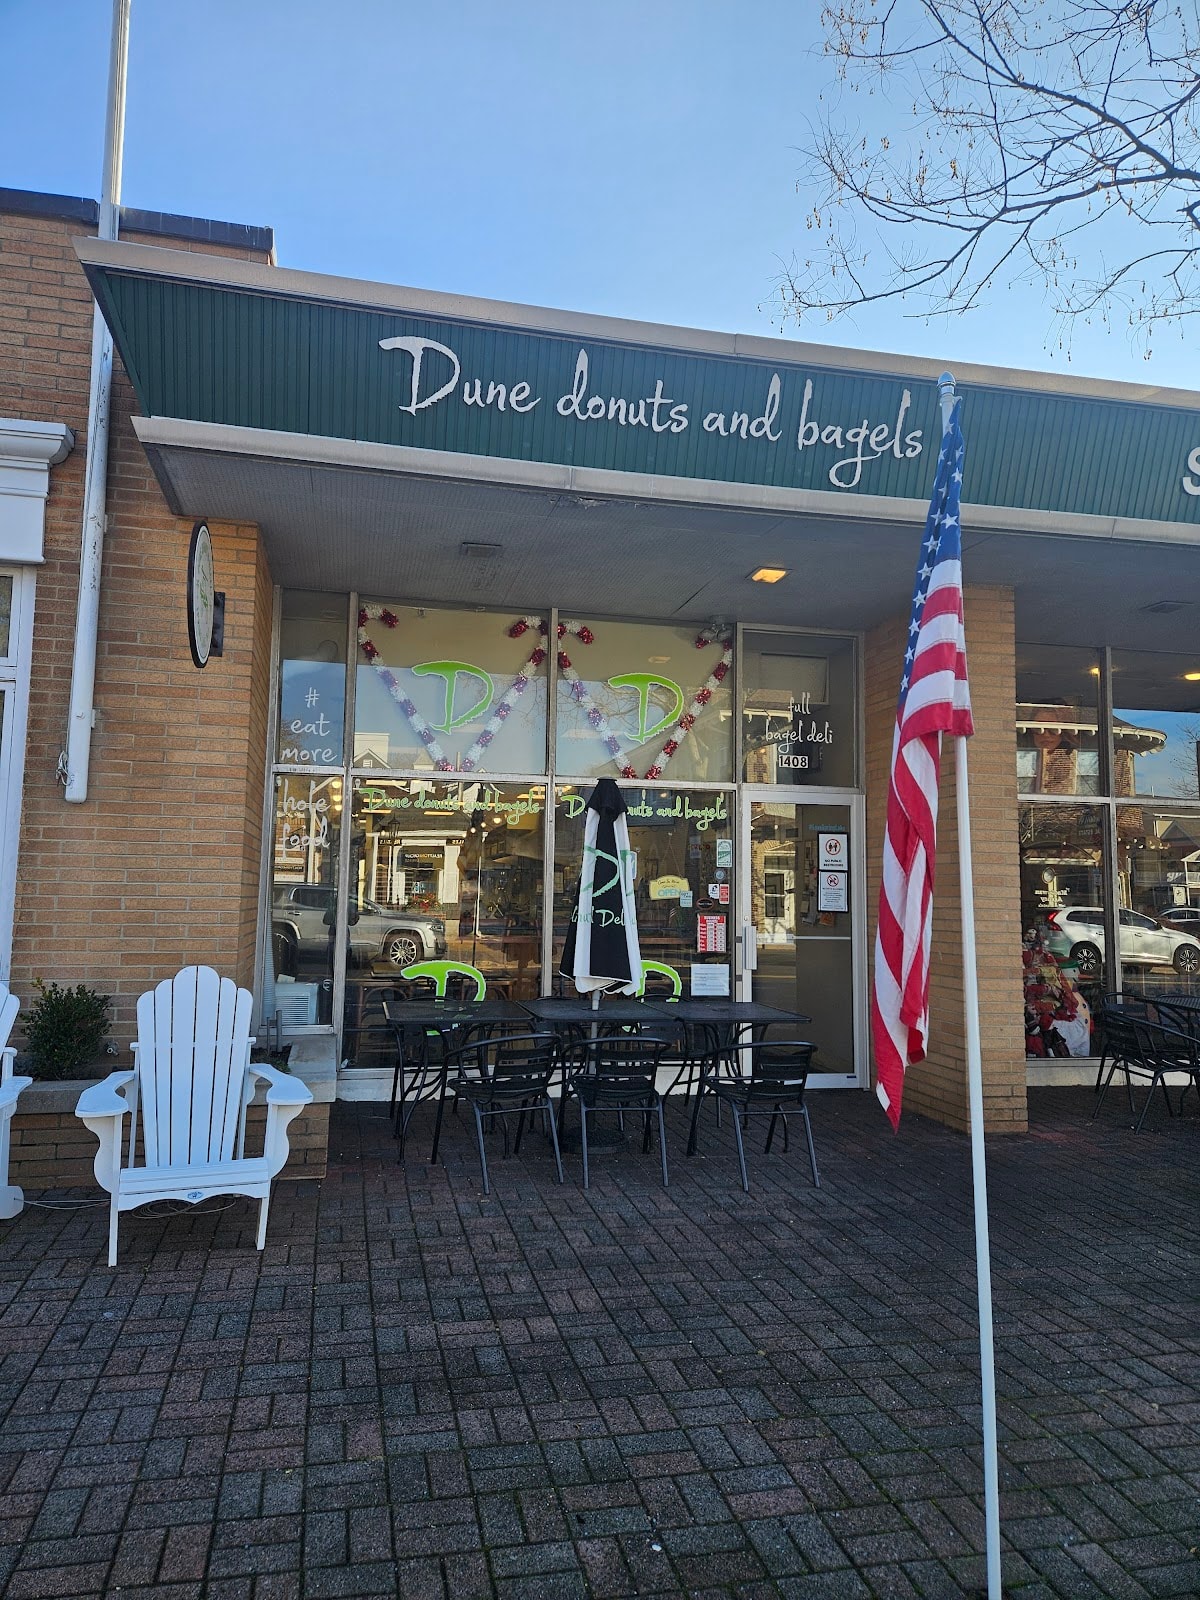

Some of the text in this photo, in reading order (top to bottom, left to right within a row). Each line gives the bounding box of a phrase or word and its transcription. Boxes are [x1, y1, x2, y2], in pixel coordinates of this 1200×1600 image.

[378, 335, 924, 488] Dune donuts and bagels
[411, 660, 494, 735] D
[608, 672, 684, 744] D
[788, 692, 811, 720] full
[290, 712, 330, 737] eat
[765, 719, 833, 753] bagel deli
[281, 747, 337, 762] more
[779, 755, 808, 768] 1408
[283, 778, 331, 816] hole
[359, 787, 411, 812] Dune
[414, 786, 460, 811] donuts
[464, 788, 491, 812] and
[494, 788, 541, 825] bagels
[626, 795, 728, 831] nuts and bagels
[279, 815, 331, 860] food
